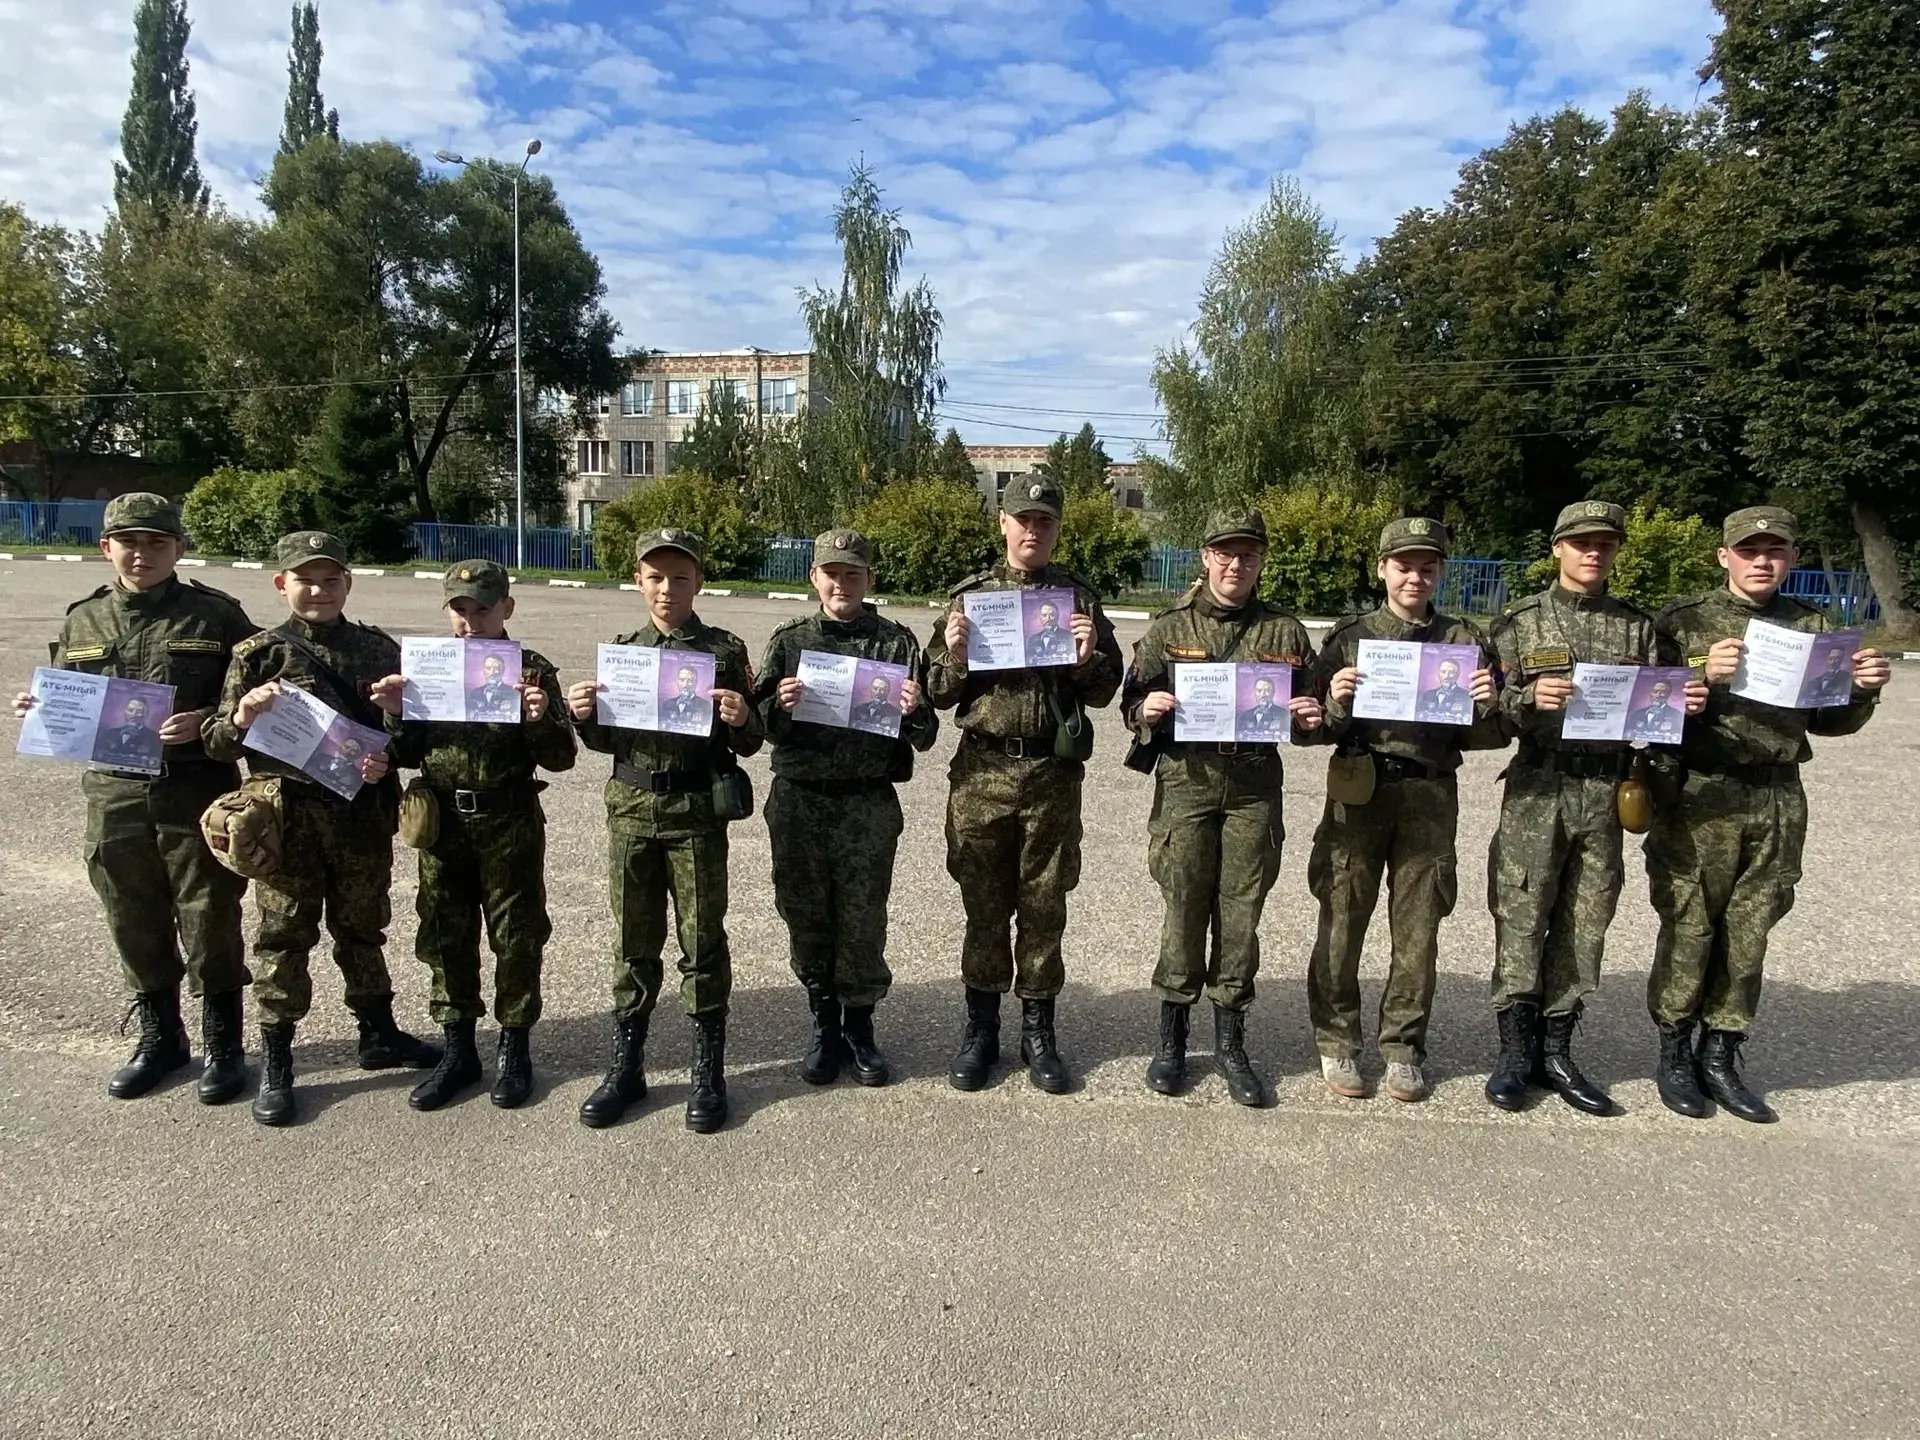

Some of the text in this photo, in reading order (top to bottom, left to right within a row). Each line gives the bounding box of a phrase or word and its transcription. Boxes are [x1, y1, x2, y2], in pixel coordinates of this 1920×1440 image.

[972, 602, 1014, 612] АТОМНЫЙ
[1754, 633, 1803, 651] АТОМНЫЙ
[410, 650, 456, 658] АТОМНЫЙ
[1366, 652, 1412, 660] АТОМНЫЙ
[606, 657, 652, 668] АТОМНЫЙ
[806, 663, 848, 674] АТОМНЫЙ
[1184, 674, 1228, 682] АТОМНЫЙ
[42, 682, 97, 695] АТОМНЫЙ
[281, 688, 325, 722] АТОМНЫЙ
